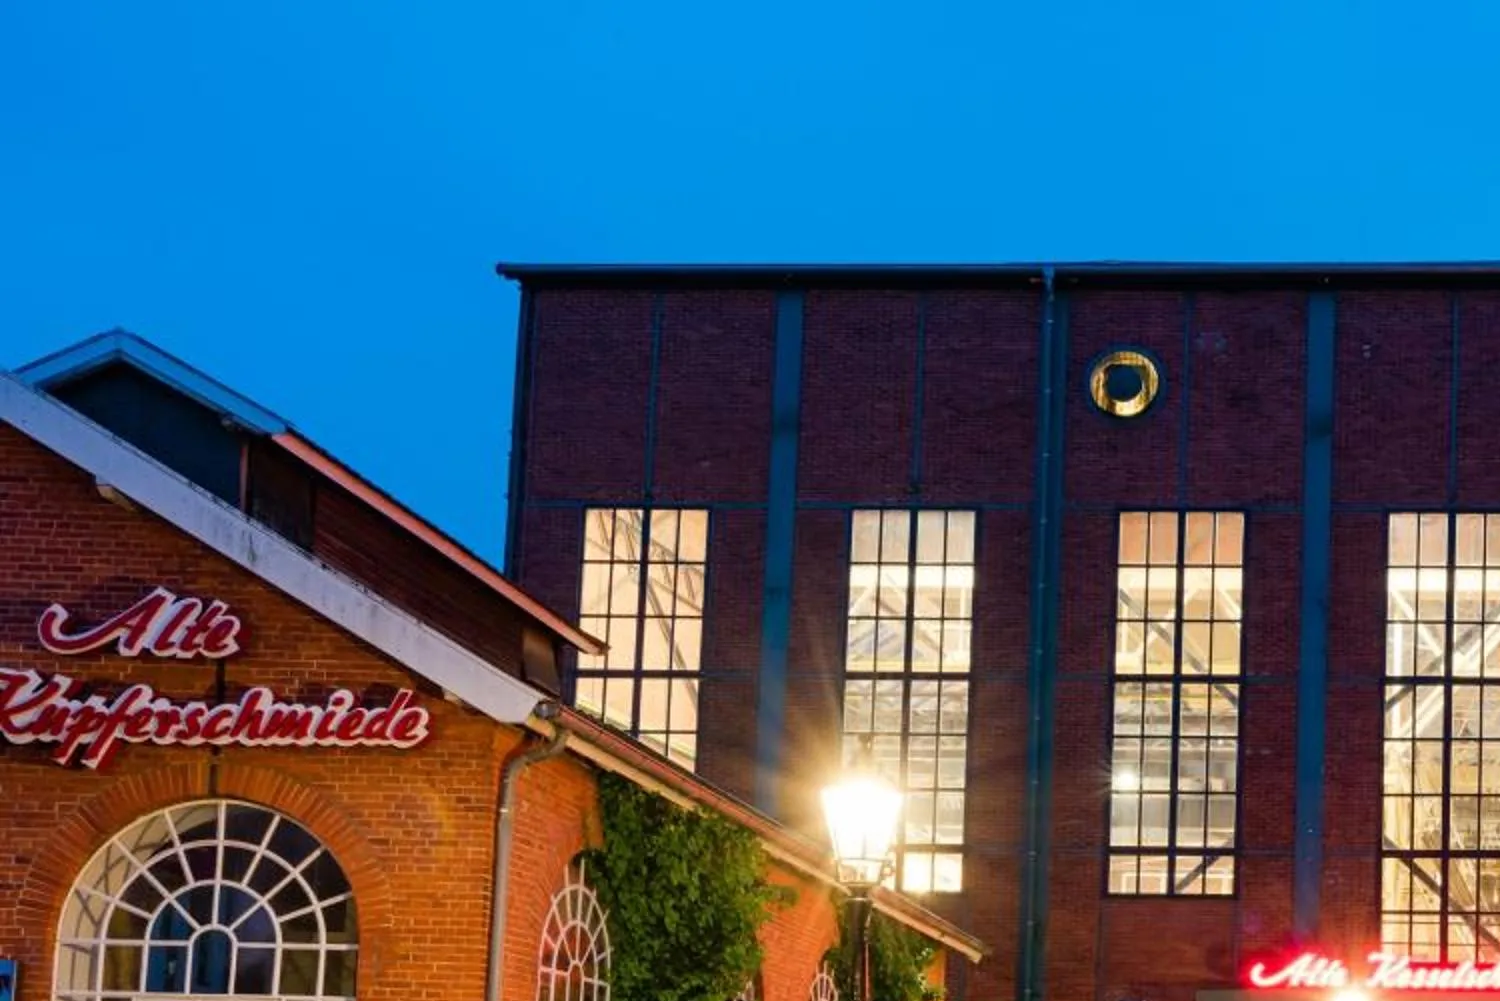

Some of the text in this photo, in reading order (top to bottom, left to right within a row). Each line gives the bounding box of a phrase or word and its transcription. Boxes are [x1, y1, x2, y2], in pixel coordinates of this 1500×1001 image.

[38, 586, 241, 658] Alte
[0, 667, 430, 770] Kupferschmiede
[1250, 952, 1348, 988] Alte
